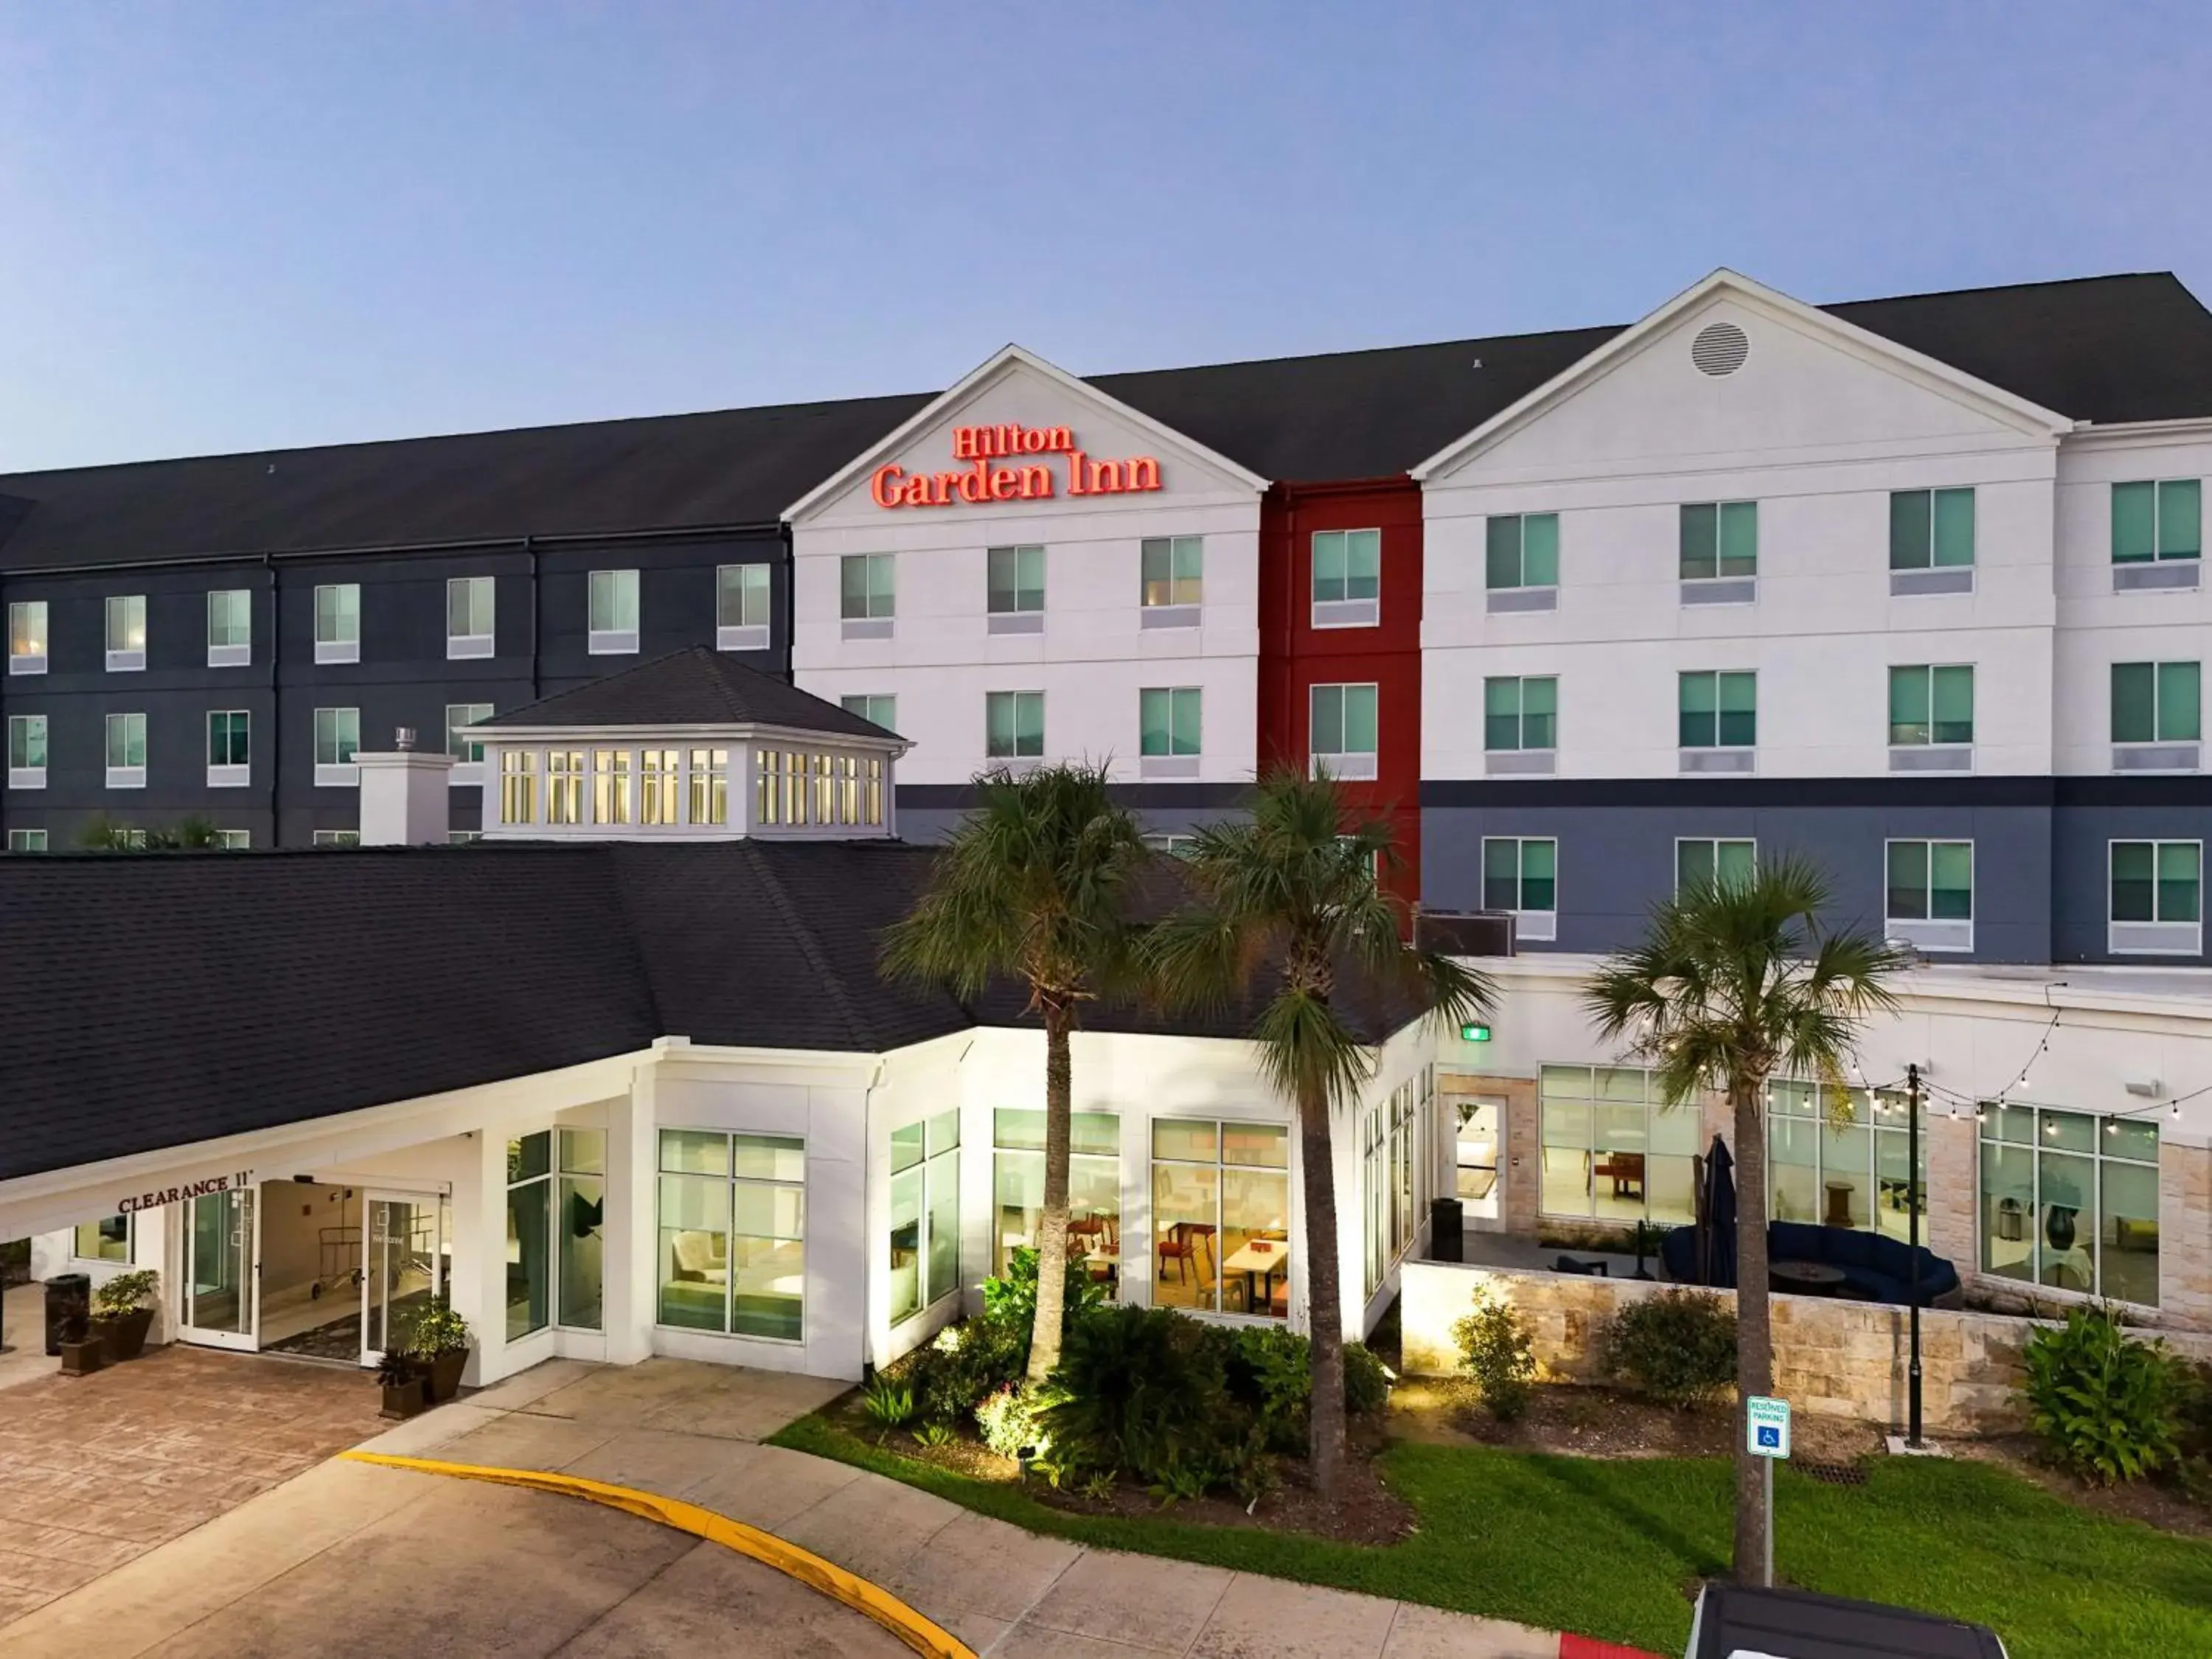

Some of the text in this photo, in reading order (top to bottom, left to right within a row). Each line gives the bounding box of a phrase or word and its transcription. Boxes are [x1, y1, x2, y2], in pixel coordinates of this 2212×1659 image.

[953, 424, 1074, 459] Hilton
[872, 451, 1162, 508] Garden Inn
[118, 1176, 229, 1214] CLEARANCE
[1751, 1402, 1788, 1413] RESERVED
[1753, 1412, 1784, 1422] PARKING
